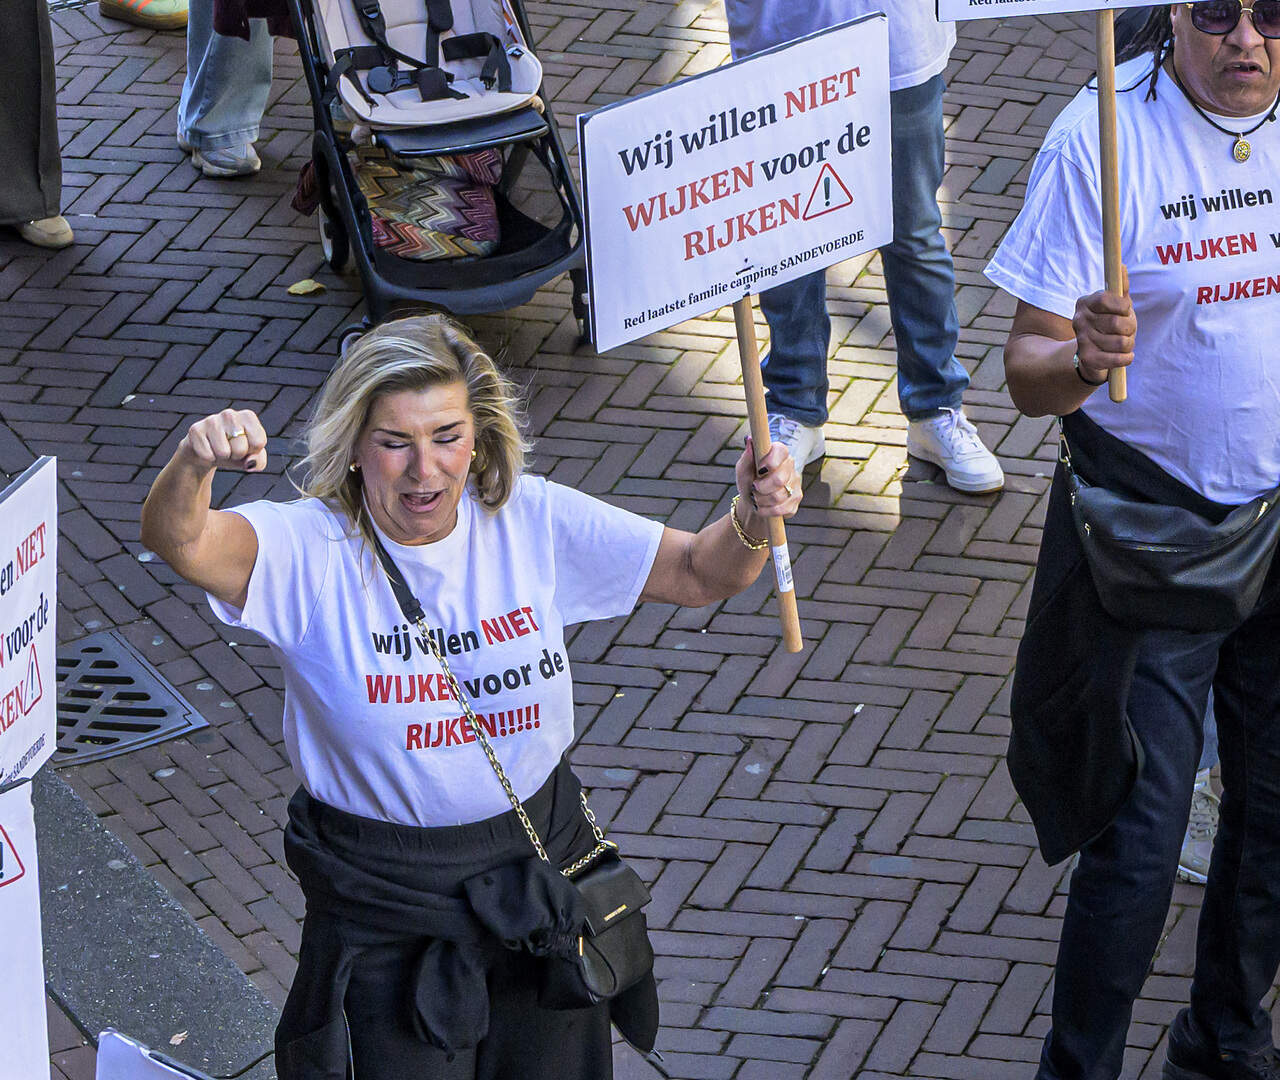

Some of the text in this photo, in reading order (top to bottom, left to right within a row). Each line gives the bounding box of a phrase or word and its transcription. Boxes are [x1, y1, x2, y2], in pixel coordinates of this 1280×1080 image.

[618, 67, 861, 177] Wij willen NIET
[622, 122, 871, 232] WIJKEN voor de
[1160, 194, 1197, 221] wij
[1201, 188, 1273, 213] willen
[683, 193, 802, 261] RIJKEN
[1156, 232, 1258, 265] WIJKEN
[623, 230, 865, 330] Red laatste familie camping SANDEVOERDE
[15, 521, 46, 582] NIET
[6, 612, 36, 661] voor
[36, 591, 49, 632] de
[371, 624, 411, 661] wij
[481, 606, 539, 645] NIET
[463, 663, 532, 699] voor
[538, 648, 565, 679] de
